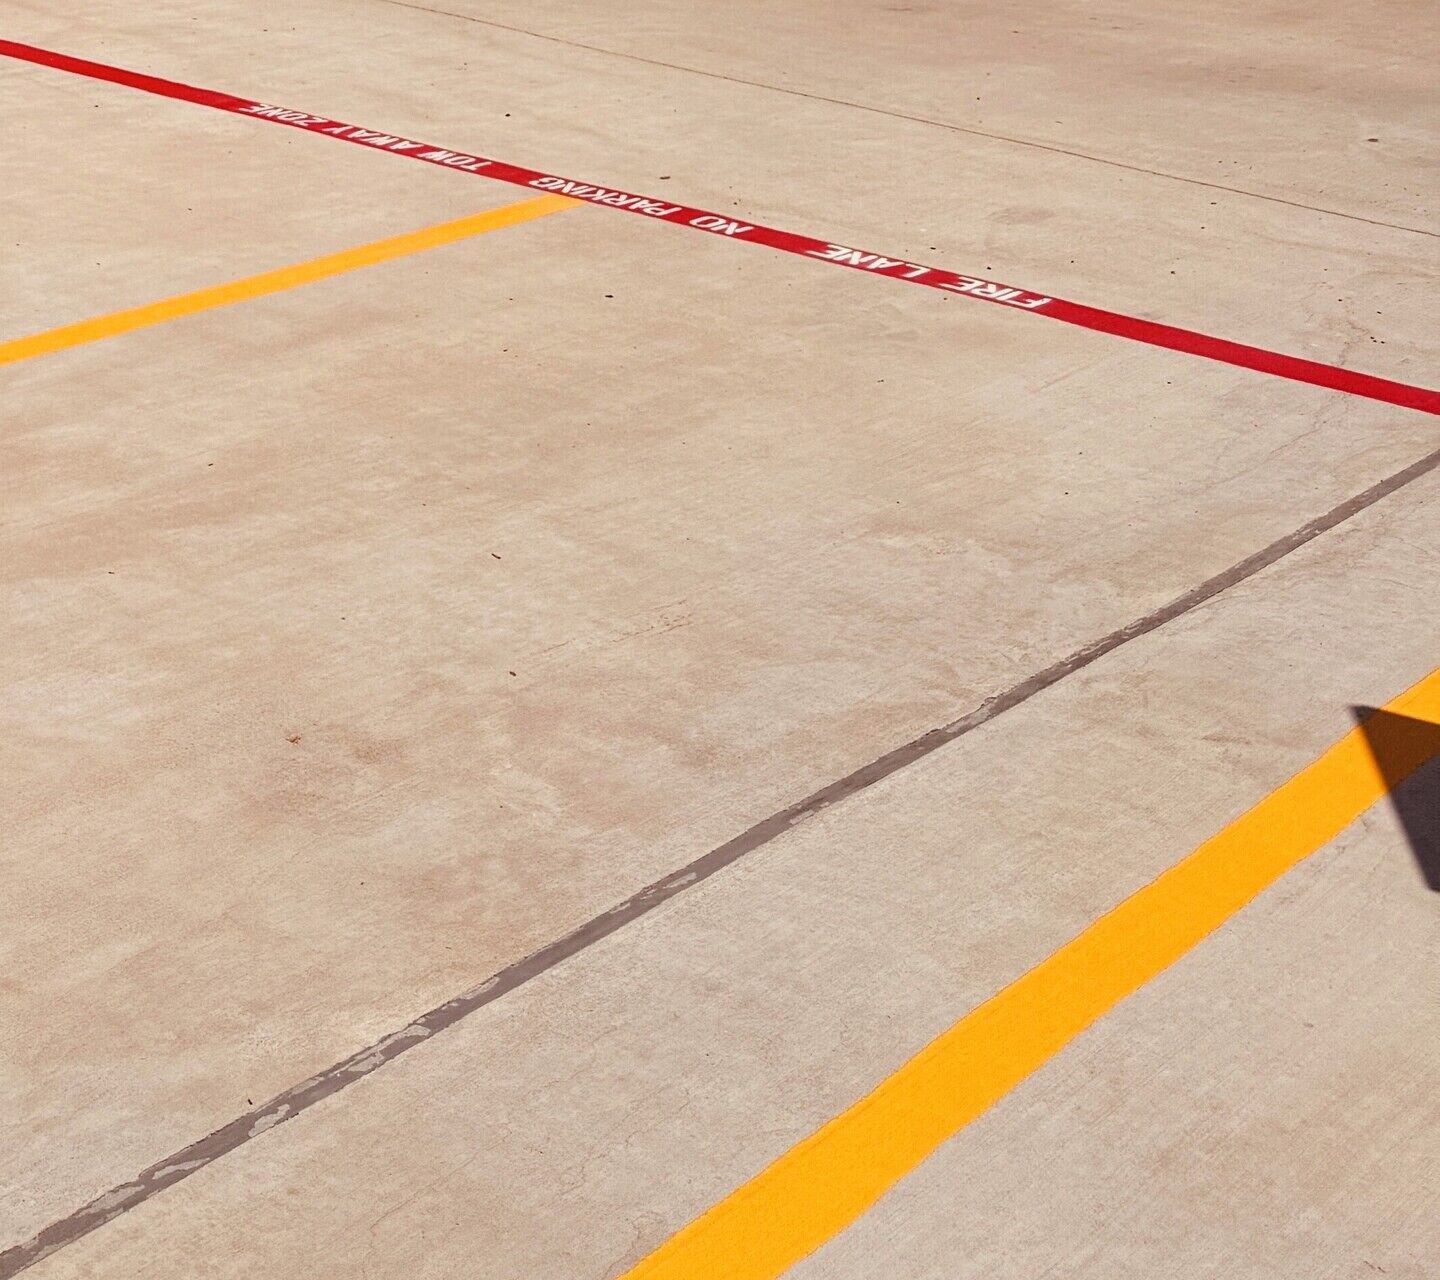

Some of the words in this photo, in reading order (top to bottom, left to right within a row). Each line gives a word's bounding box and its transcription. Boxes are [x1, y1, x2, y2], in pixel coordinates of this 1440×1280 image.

[238, 103, 328, 127] ZONE
[324, 121, 423, 150] AWAY
[418, 150, 492, 171] TOW
[529, 177, 682, 216] PARKING
[688, 215, 753, 235] NO
[805, 244, 931, 278] LANE
[938, 276, 1052, 309] FIRE
